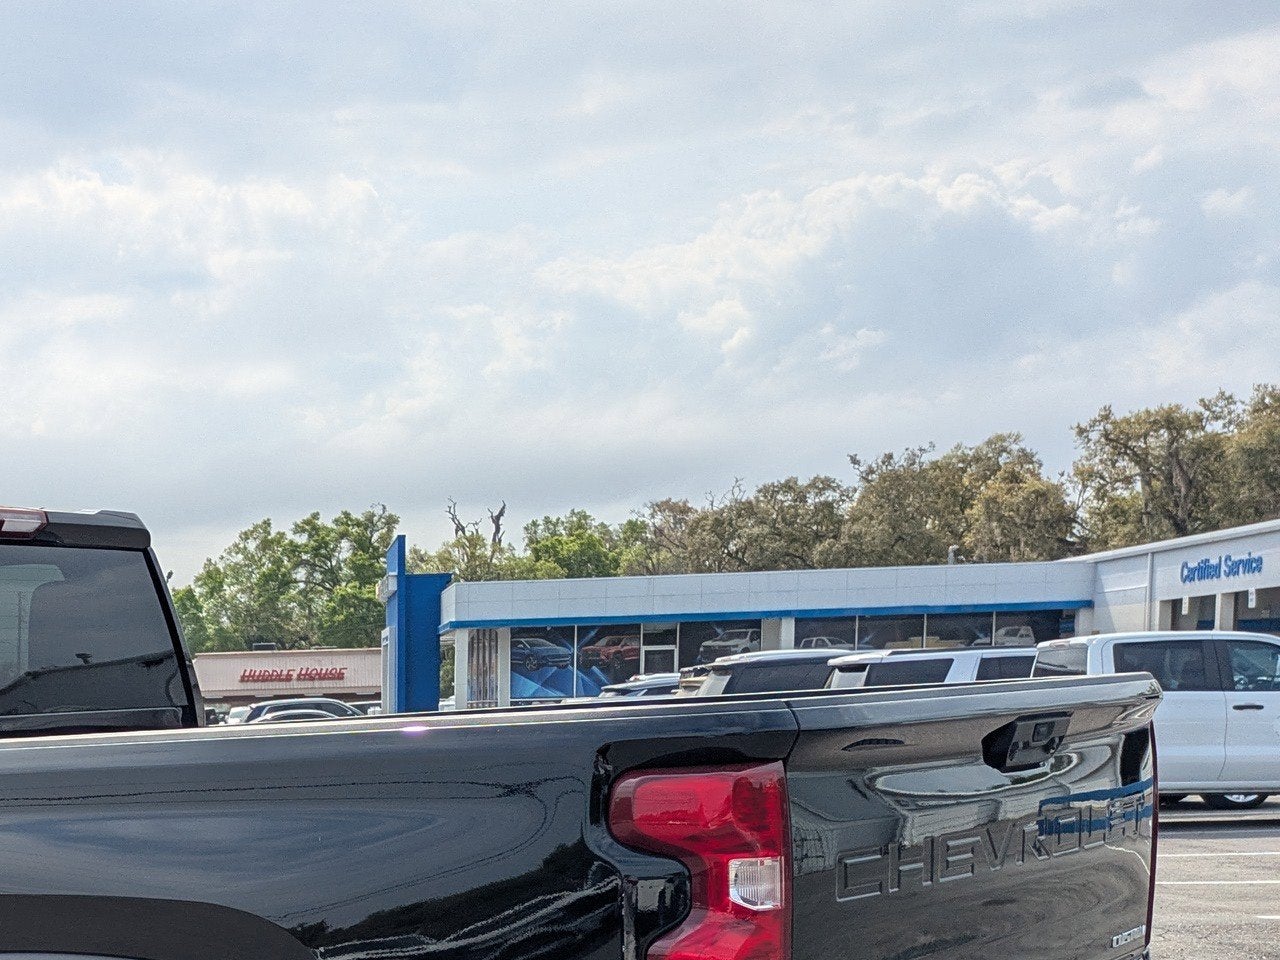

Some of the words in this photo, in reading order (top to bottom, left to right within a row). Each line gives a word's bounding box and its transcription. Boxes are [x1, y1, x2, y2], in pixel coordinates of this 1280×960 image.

[1180, 556, 1222, 583] Certified
[1223, 551, 1263, 578] Service
[239, 668, 295, 683] HUDDLE
[296, 667, 348, 681] HOUSE
